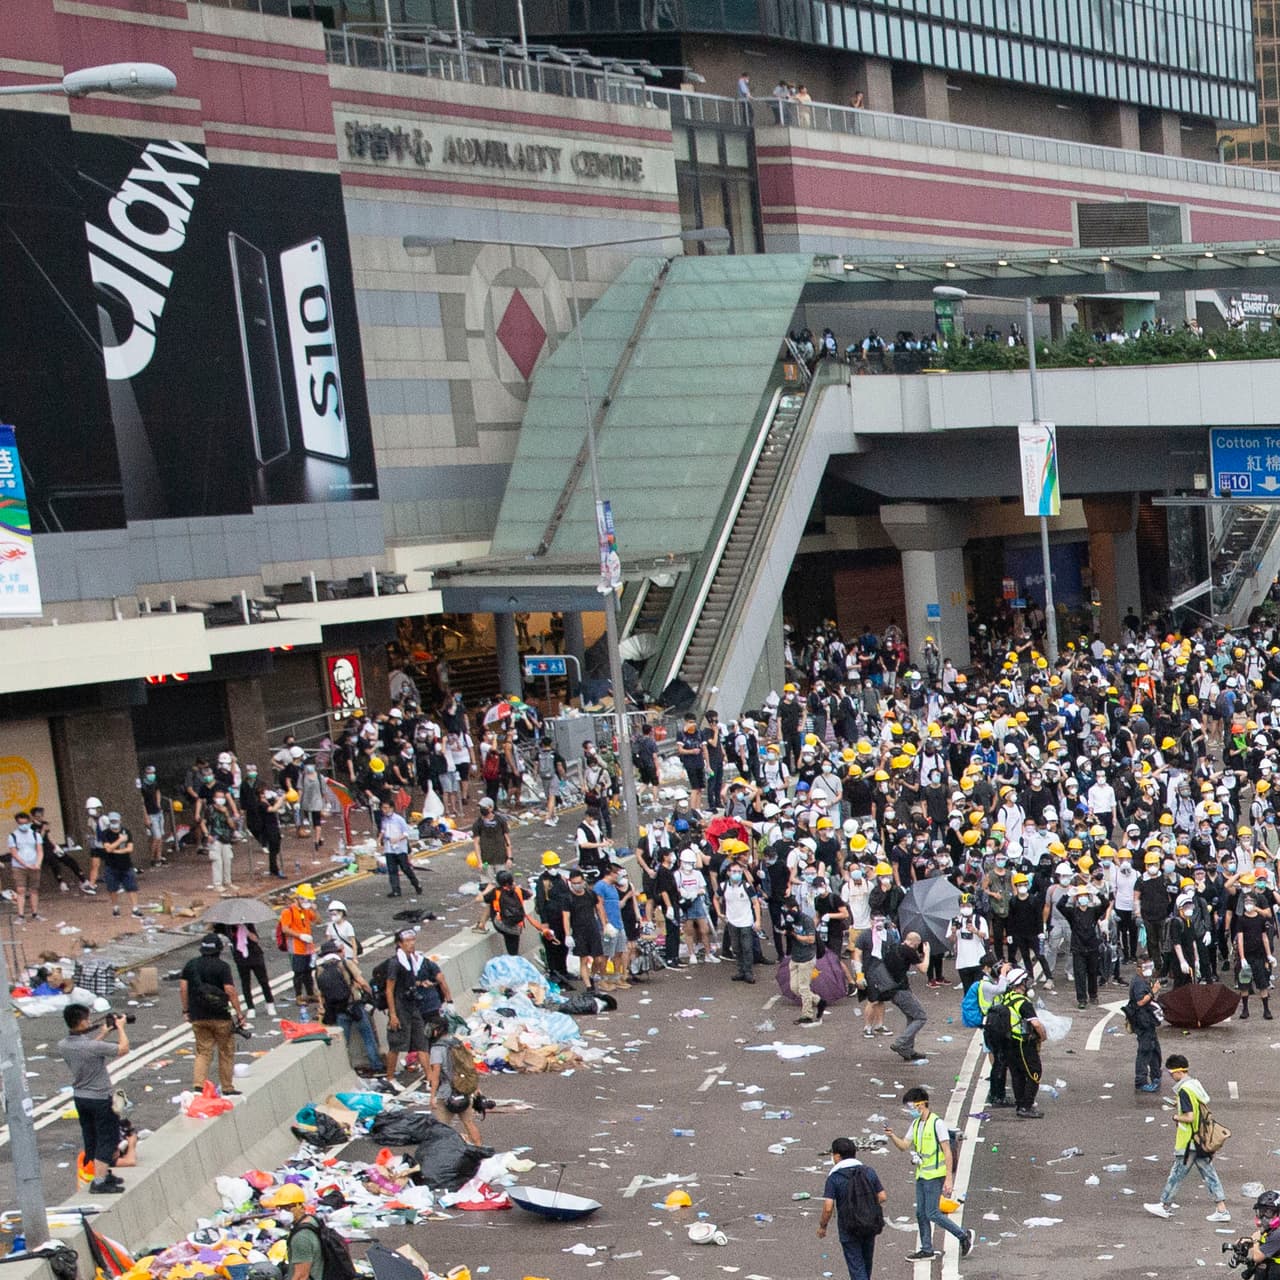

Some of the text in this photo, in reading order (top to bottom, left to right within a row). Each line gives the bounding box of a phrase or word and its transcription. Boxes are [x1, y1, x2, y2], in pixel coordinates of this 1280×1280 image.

[570, 149, 645, 183] CENTRE
[300, 284, 343, 422] S10
[1216, 437, 1260, 448] Cotton
[1231, 476, 1249, 489] 10
